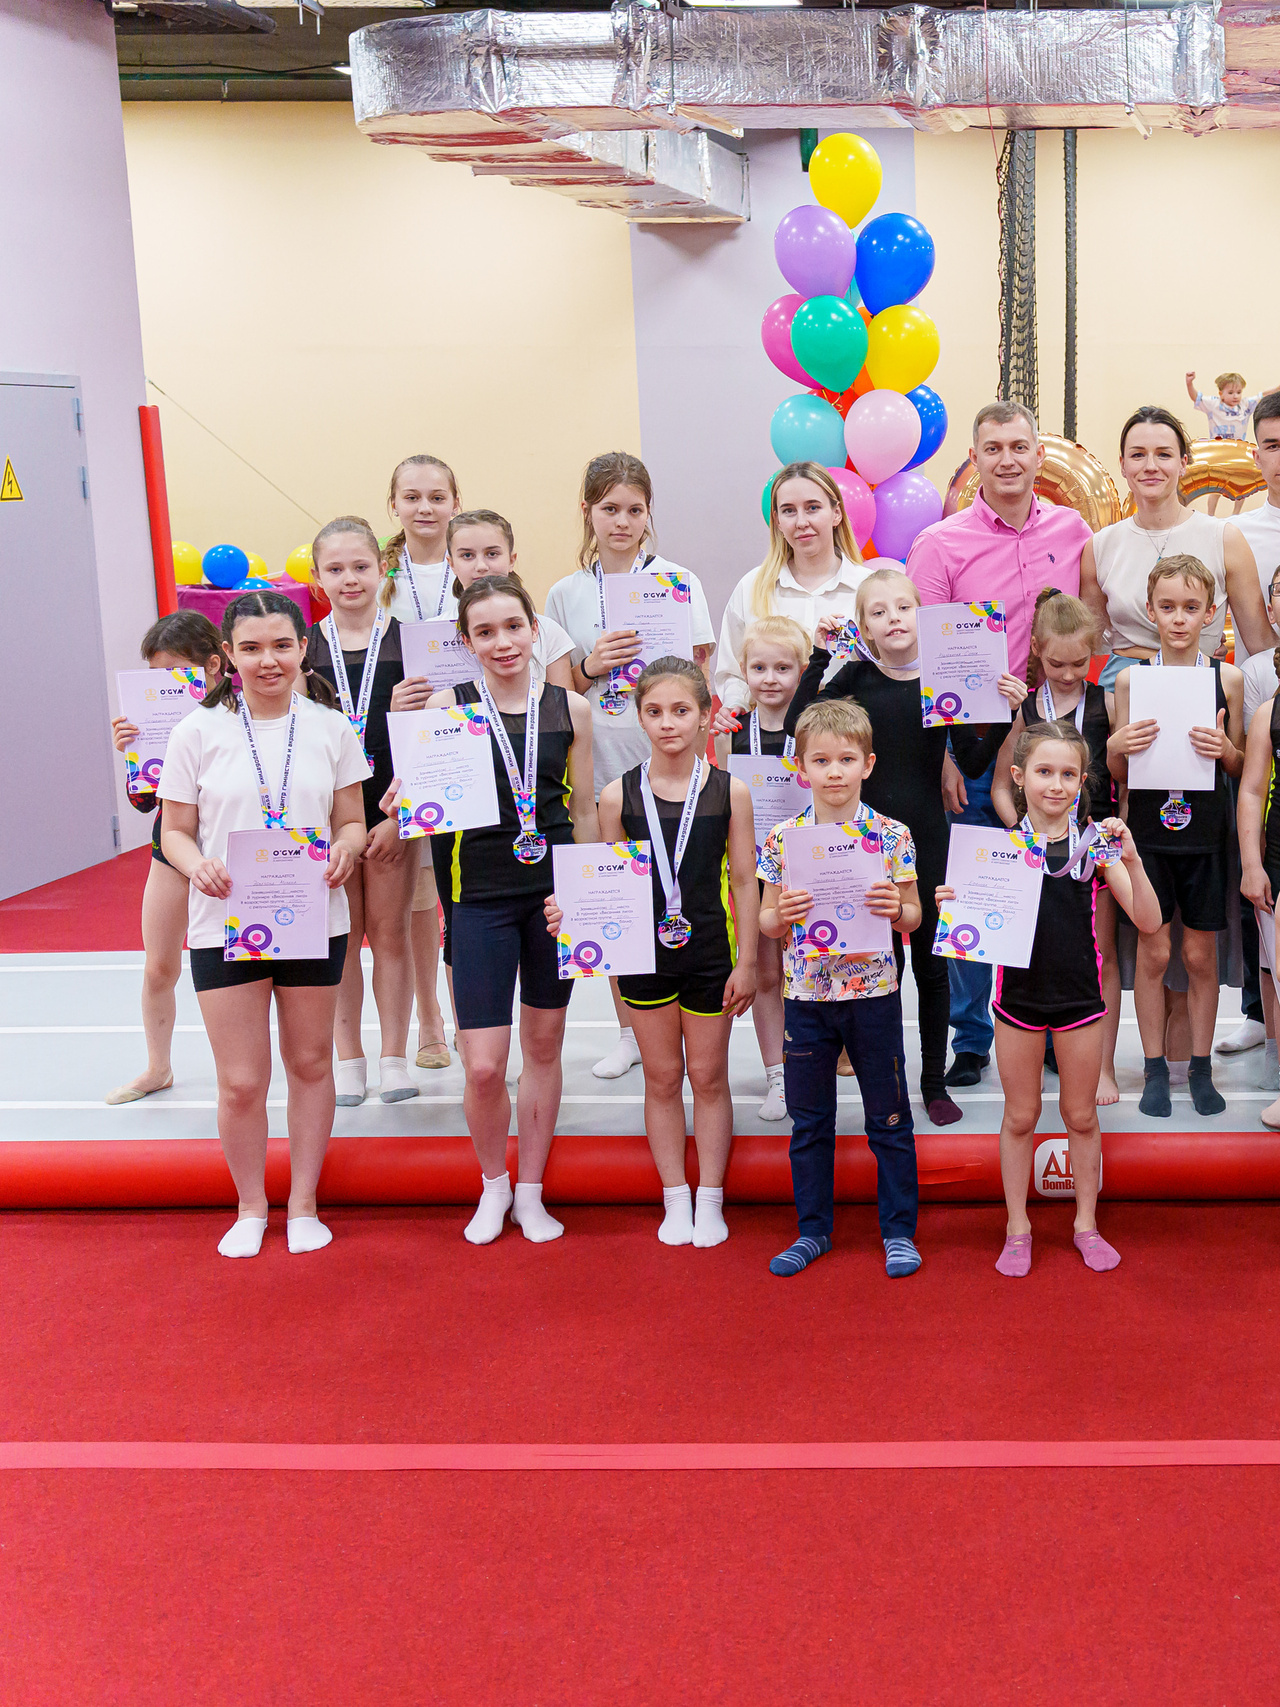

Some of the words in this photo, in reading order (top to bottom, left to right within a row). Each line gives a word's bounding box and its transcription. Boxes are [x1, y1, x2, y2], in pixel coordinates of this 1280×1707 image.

[434, 728, 462, 736] O'GYM
[282, 754, 292, 791] гимнастики
[828, 844, 855, 852] O'GYM
[992, 851, 1018, 860] O'GYM
